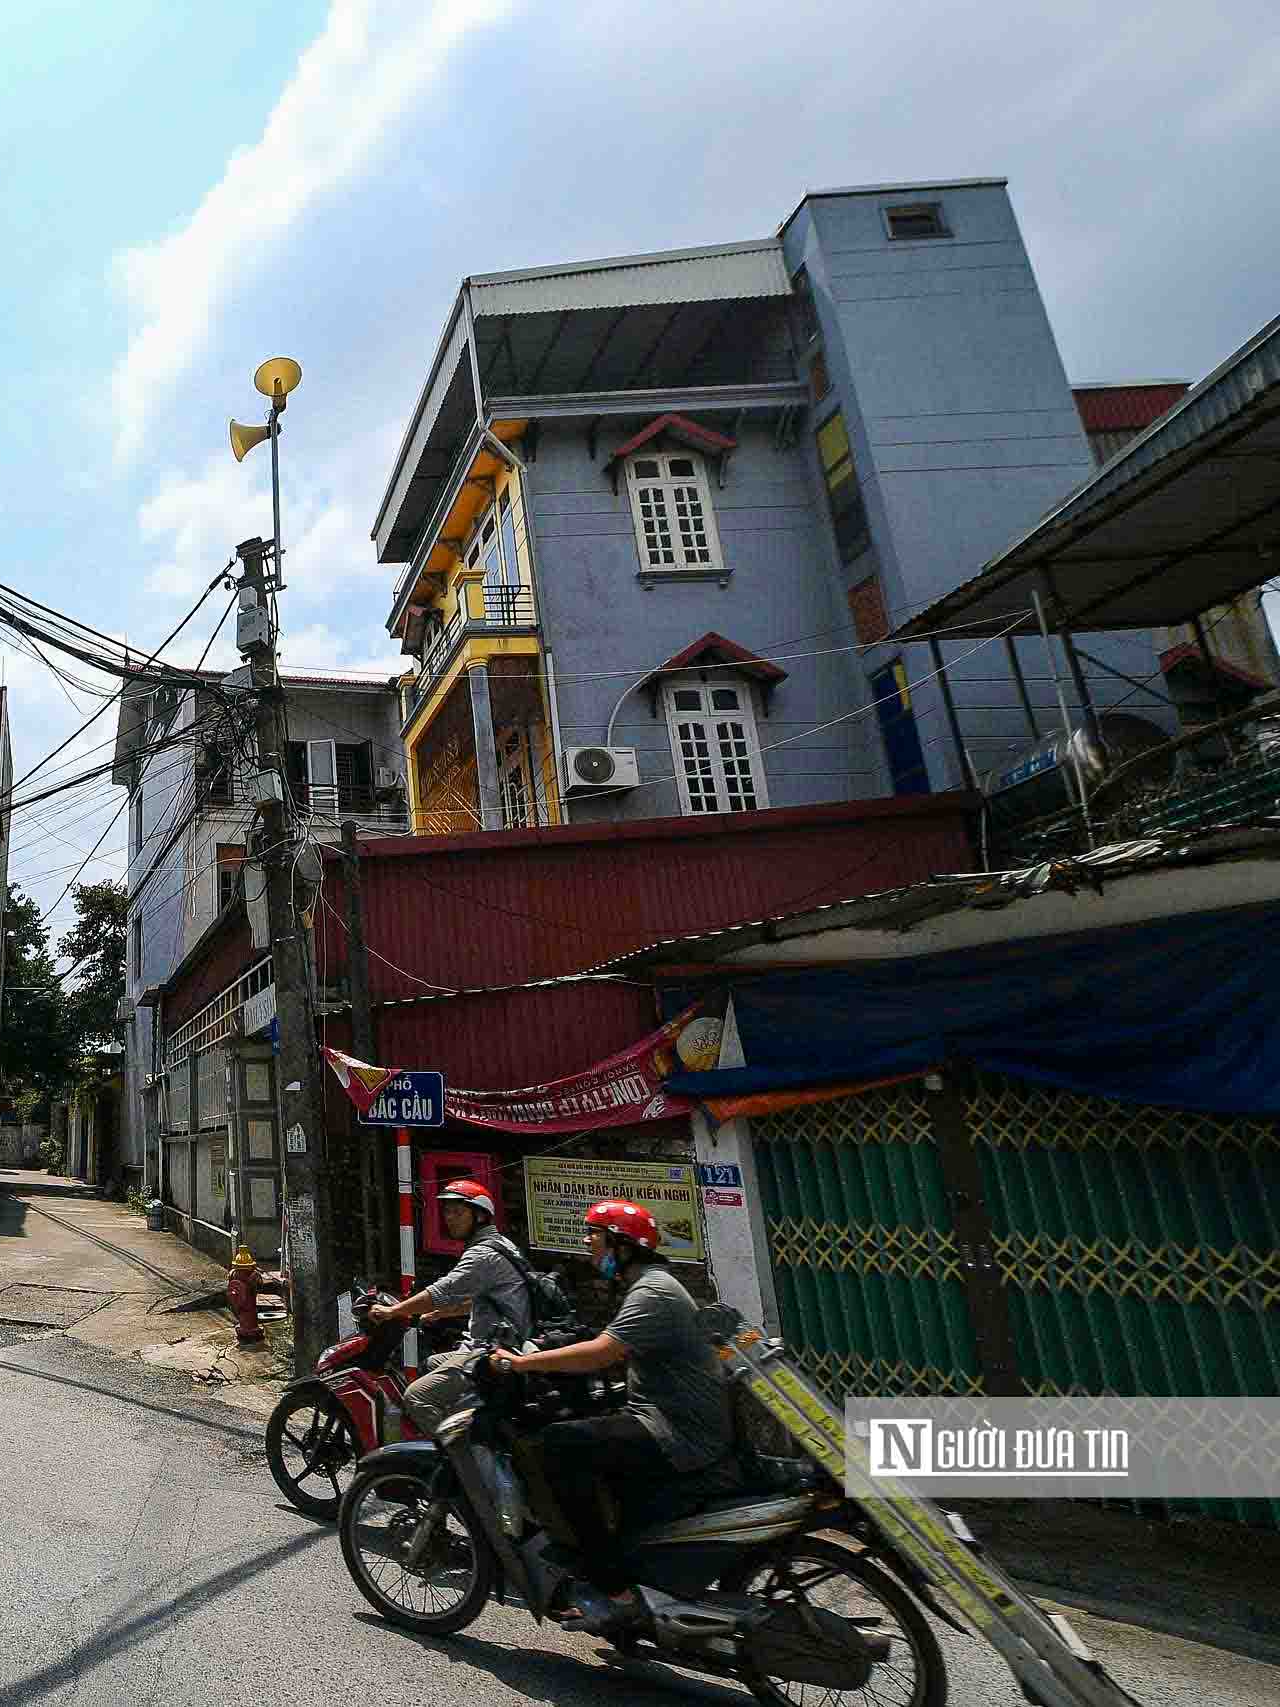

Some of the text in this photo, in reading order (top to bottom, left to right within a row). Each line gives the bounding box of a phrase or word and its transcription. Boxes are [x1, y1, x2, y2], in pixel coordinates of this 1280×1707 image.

[401, 1090, 433, 1121] CẦU
[705, 1166, 737, 1185] 121
[533, 1179, 562, 1193] NHÂN
[564, 1180, 586, 1195] DÂN
[588, 1180, 610, 1197] BẮC
[612, 1181, 634, 1198] CẦU
[636, 1183, 661, 1201] KIẾN
